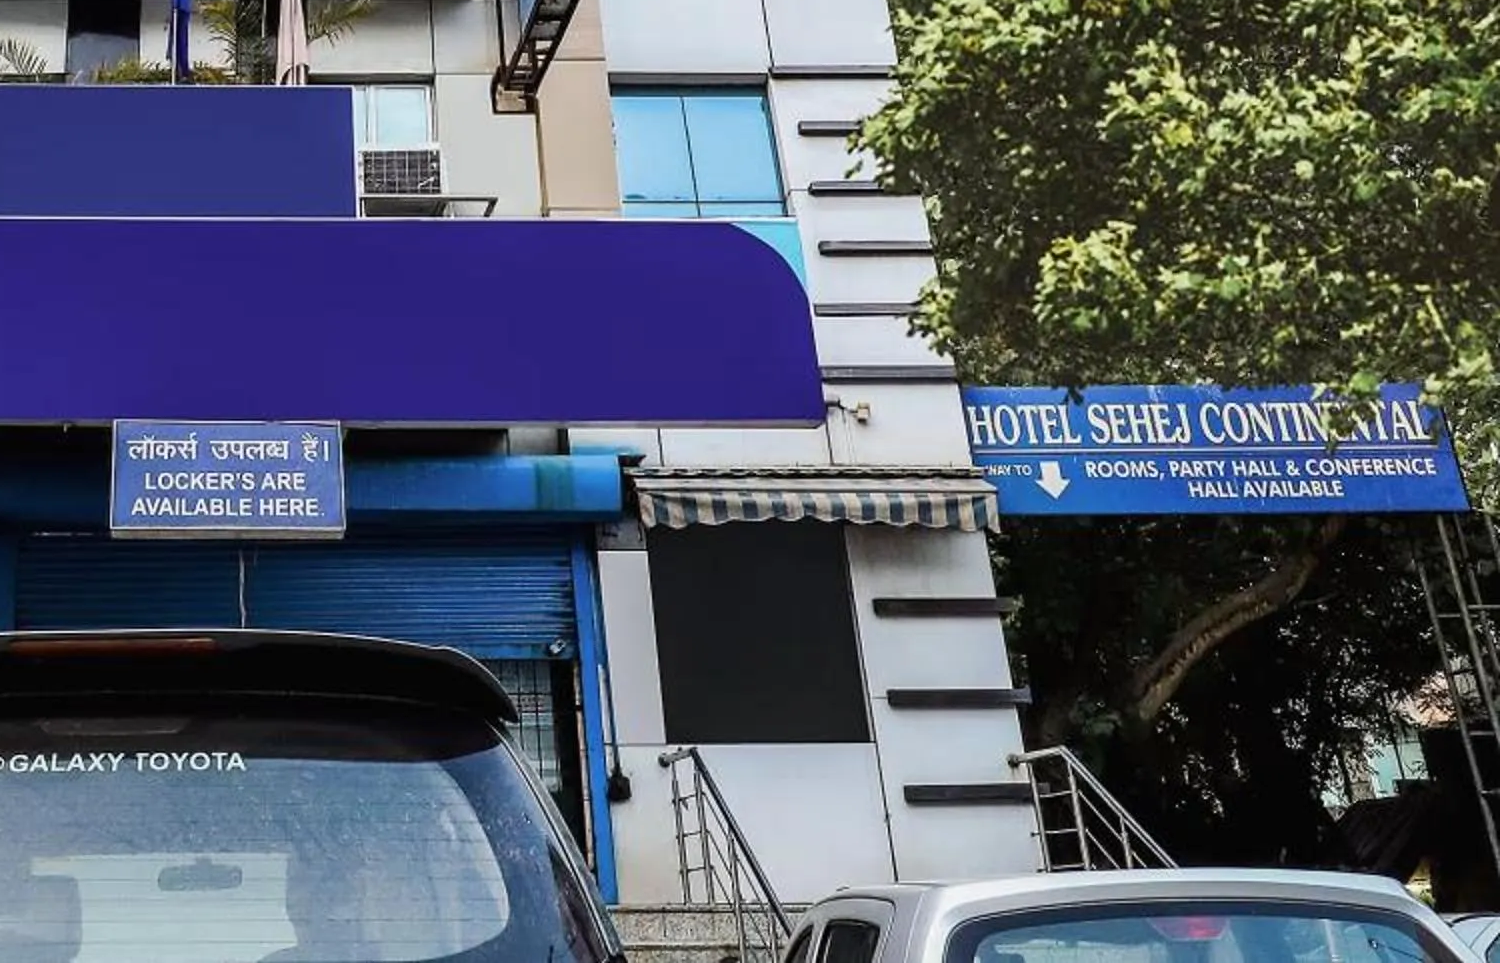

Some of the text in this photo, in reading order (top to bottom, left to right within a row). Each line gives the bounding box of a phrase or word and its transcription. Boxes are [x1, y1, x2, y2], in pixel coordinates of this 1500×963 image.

[966, 404, 1082, 445] HOTEL
[1087, 402, 1191, 445] SEHEJ
[127, 431, 198, 461] लॉकर्स
[209, 439, 289, 461] उपलब्ध
[1013, 464, 1033, 476] TO
[1085, 457, 1437, 480] ROOMS, PARTY HALL & CONFERENCE
[145, 472, 306, 491] LOCKER'S ARE
[1187, 480, 1345, 498] HALL AVAILABLE
[131, 498, 325, 517] AVAILABLE HERE.
[9, 751, 247, 772] GALAXY TOYOTA
